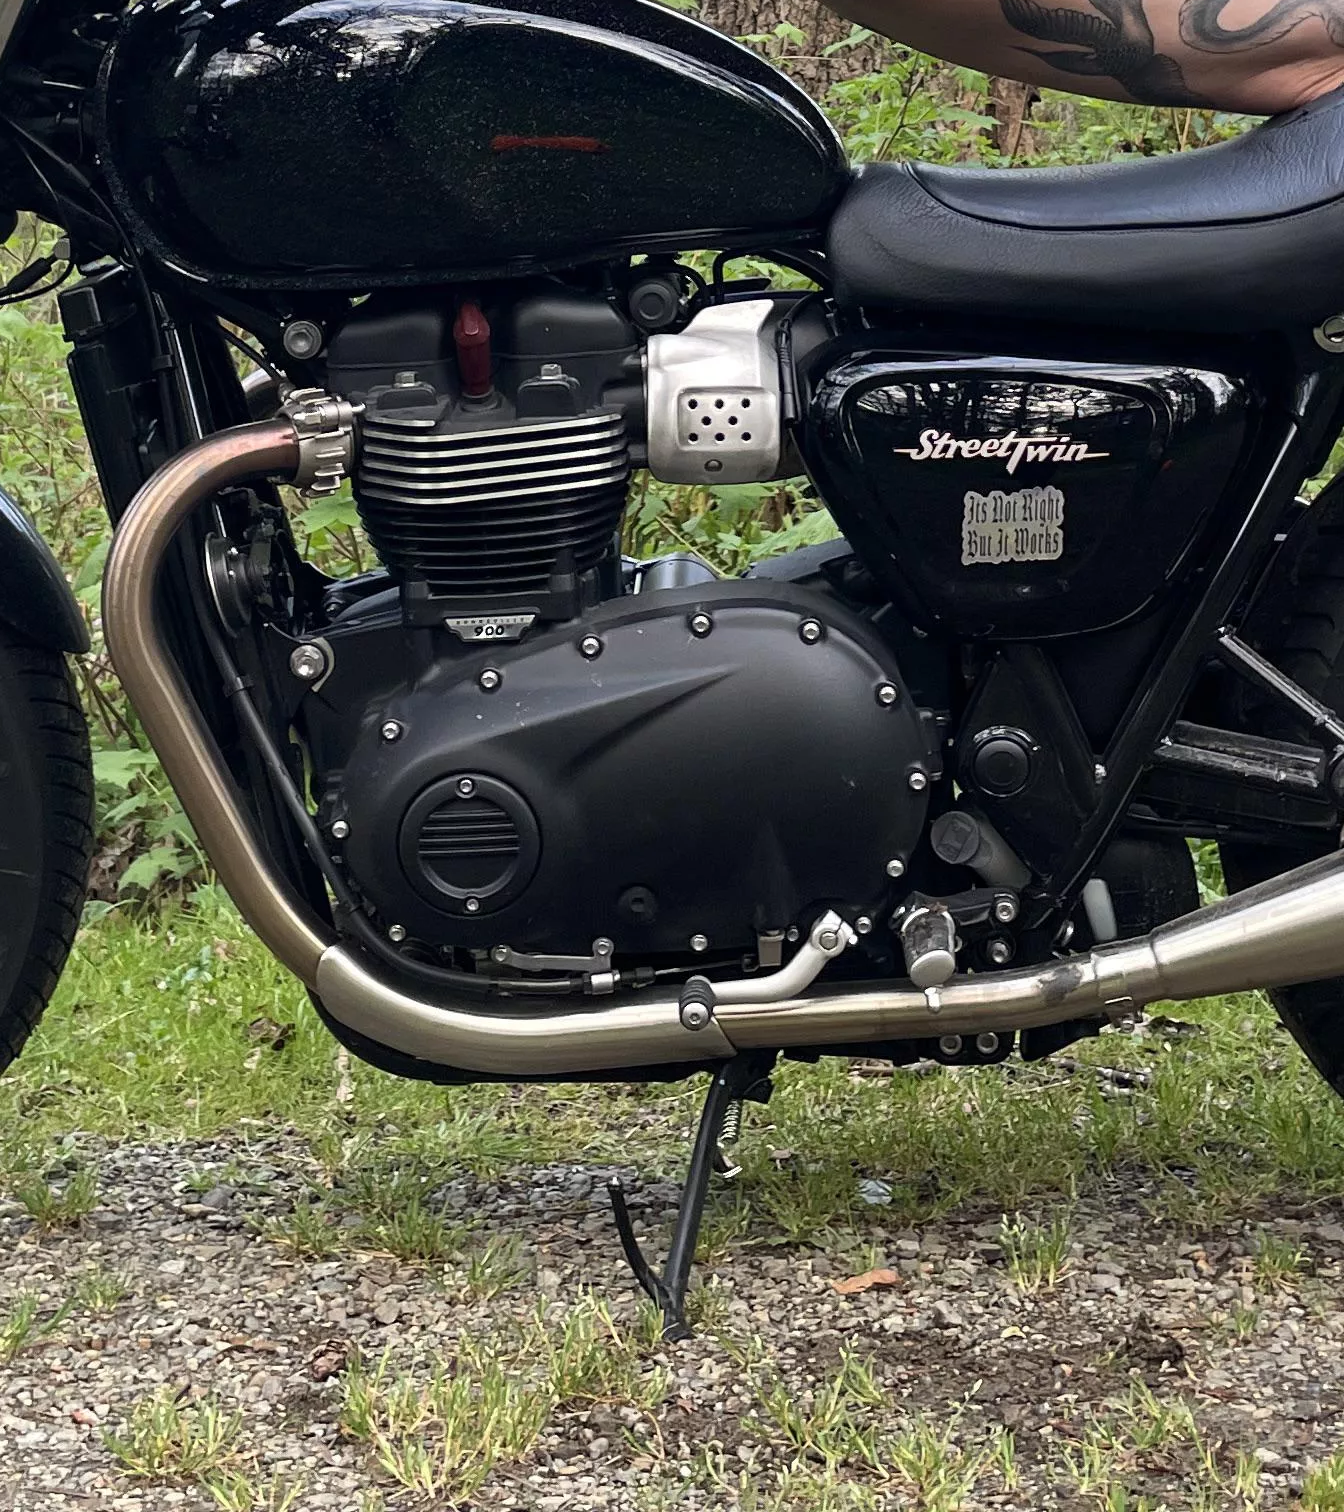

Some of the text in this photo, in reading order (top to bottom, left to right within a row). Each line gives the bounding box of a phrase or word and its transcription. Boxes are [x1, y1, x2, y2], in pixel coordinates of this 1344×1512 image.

[967, 492, 1062, 528] Its Not Right
[967, 525, 1059, 558] But It Works
[474, 625, 505, 637] 900
